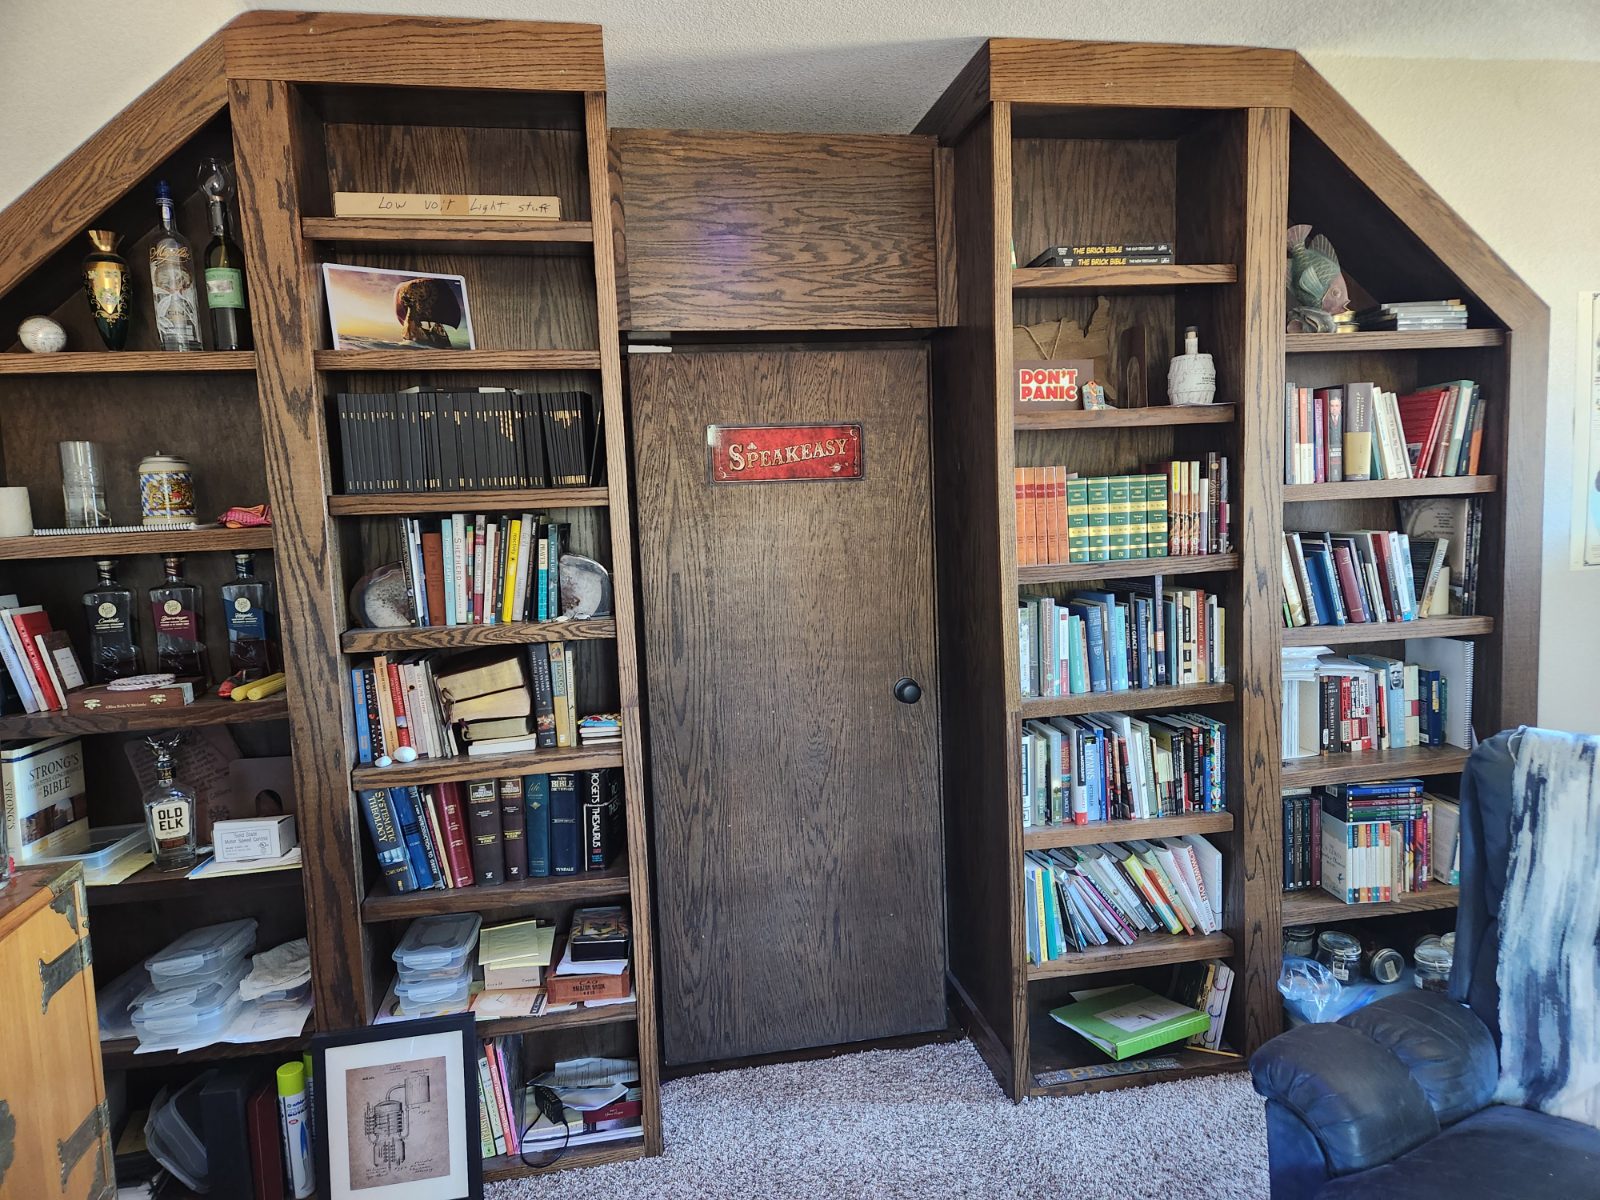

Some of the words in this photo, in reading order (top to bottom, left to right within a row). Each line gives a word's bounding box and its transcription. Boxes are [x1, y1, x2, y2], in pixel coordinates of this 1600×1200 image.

[379, 196, 406, 209] Low
[1020, 369, 1078, 385] DON'T
[1020, 386, 1078, 402] PANIC
[728, 438, 849, 471] SPEAKEASY
[454, 538, 463, 580] SHEPHERD
[364, 674, 373, 709] RADICAL
[557, 663, 565, 695] TYPOLOGY
[29, 753, 79, 781] STRONG'S
[1086, 750, 1094, 780] HYMNS
[43, 777, 71, 797] BIBLE
[551, 780, 574, 788] BIBLE
[5, 782, 15, 830] STRONG'S
[158, 806, 182, 819] OLD
[367, 795, 387, 843] THEOLOGY
[375, 790, 397, 843] SYSTEMATIC
[159, 818, 184, 831] ELK
[417, 815, 431, 850] INTRODUCTION
[591, 806, 601, 848] THESAURUS
